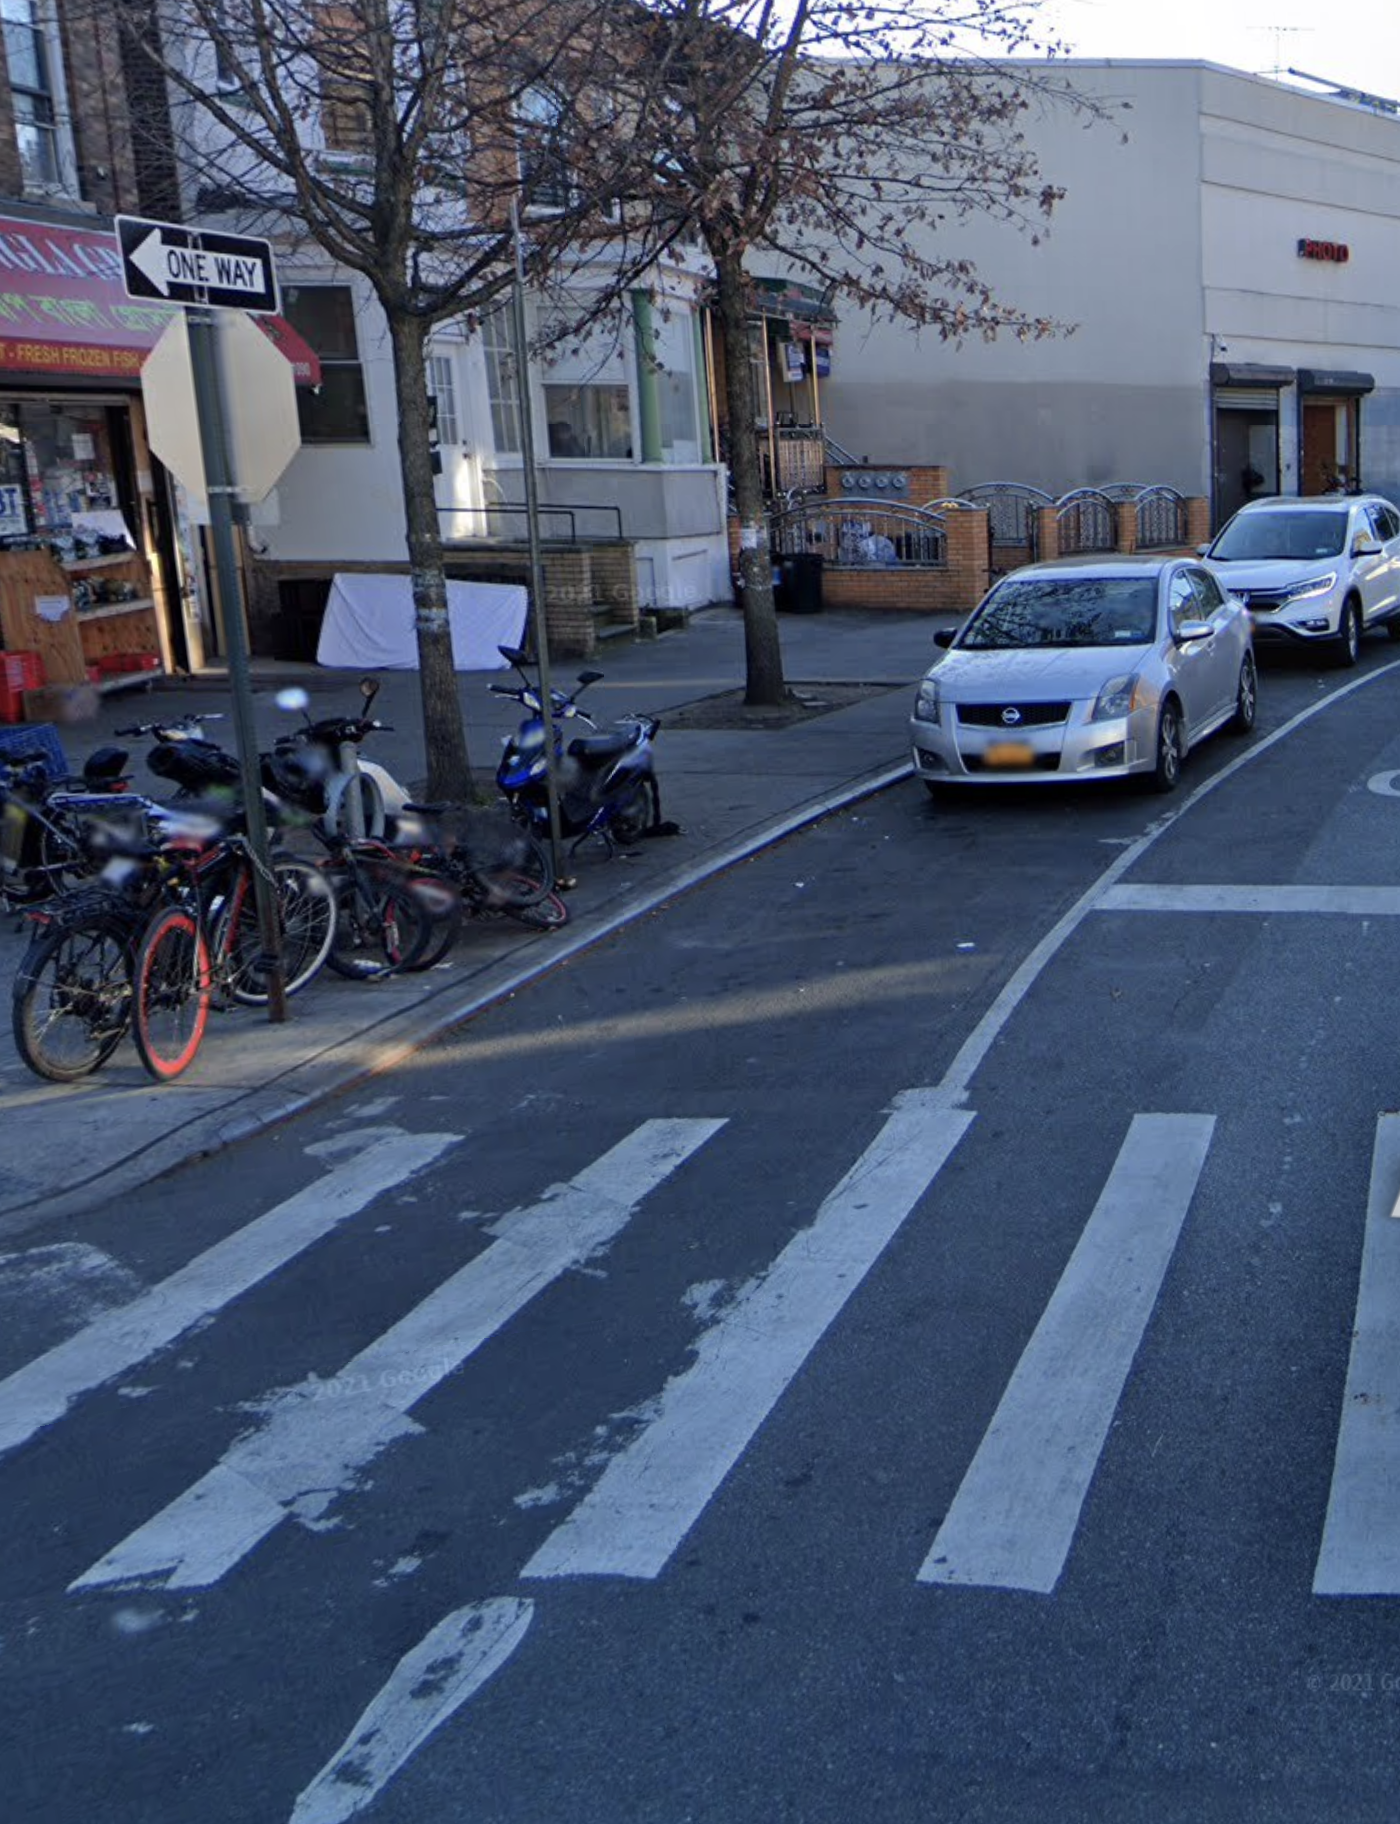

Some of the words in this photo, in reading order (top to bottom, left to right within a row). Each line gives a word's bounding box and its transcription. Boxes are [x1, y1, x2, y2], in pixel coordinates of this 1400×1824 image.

[1298, 238, 1349, 263] PHOTO
[167, 249, 210, 282] ONE
[214, 256, 257, 288] WAY
[16, 343, 61, 364] FRESH
[63, 348, 110, 367] FROZEN
[114, 352, 140, 368] FISH
